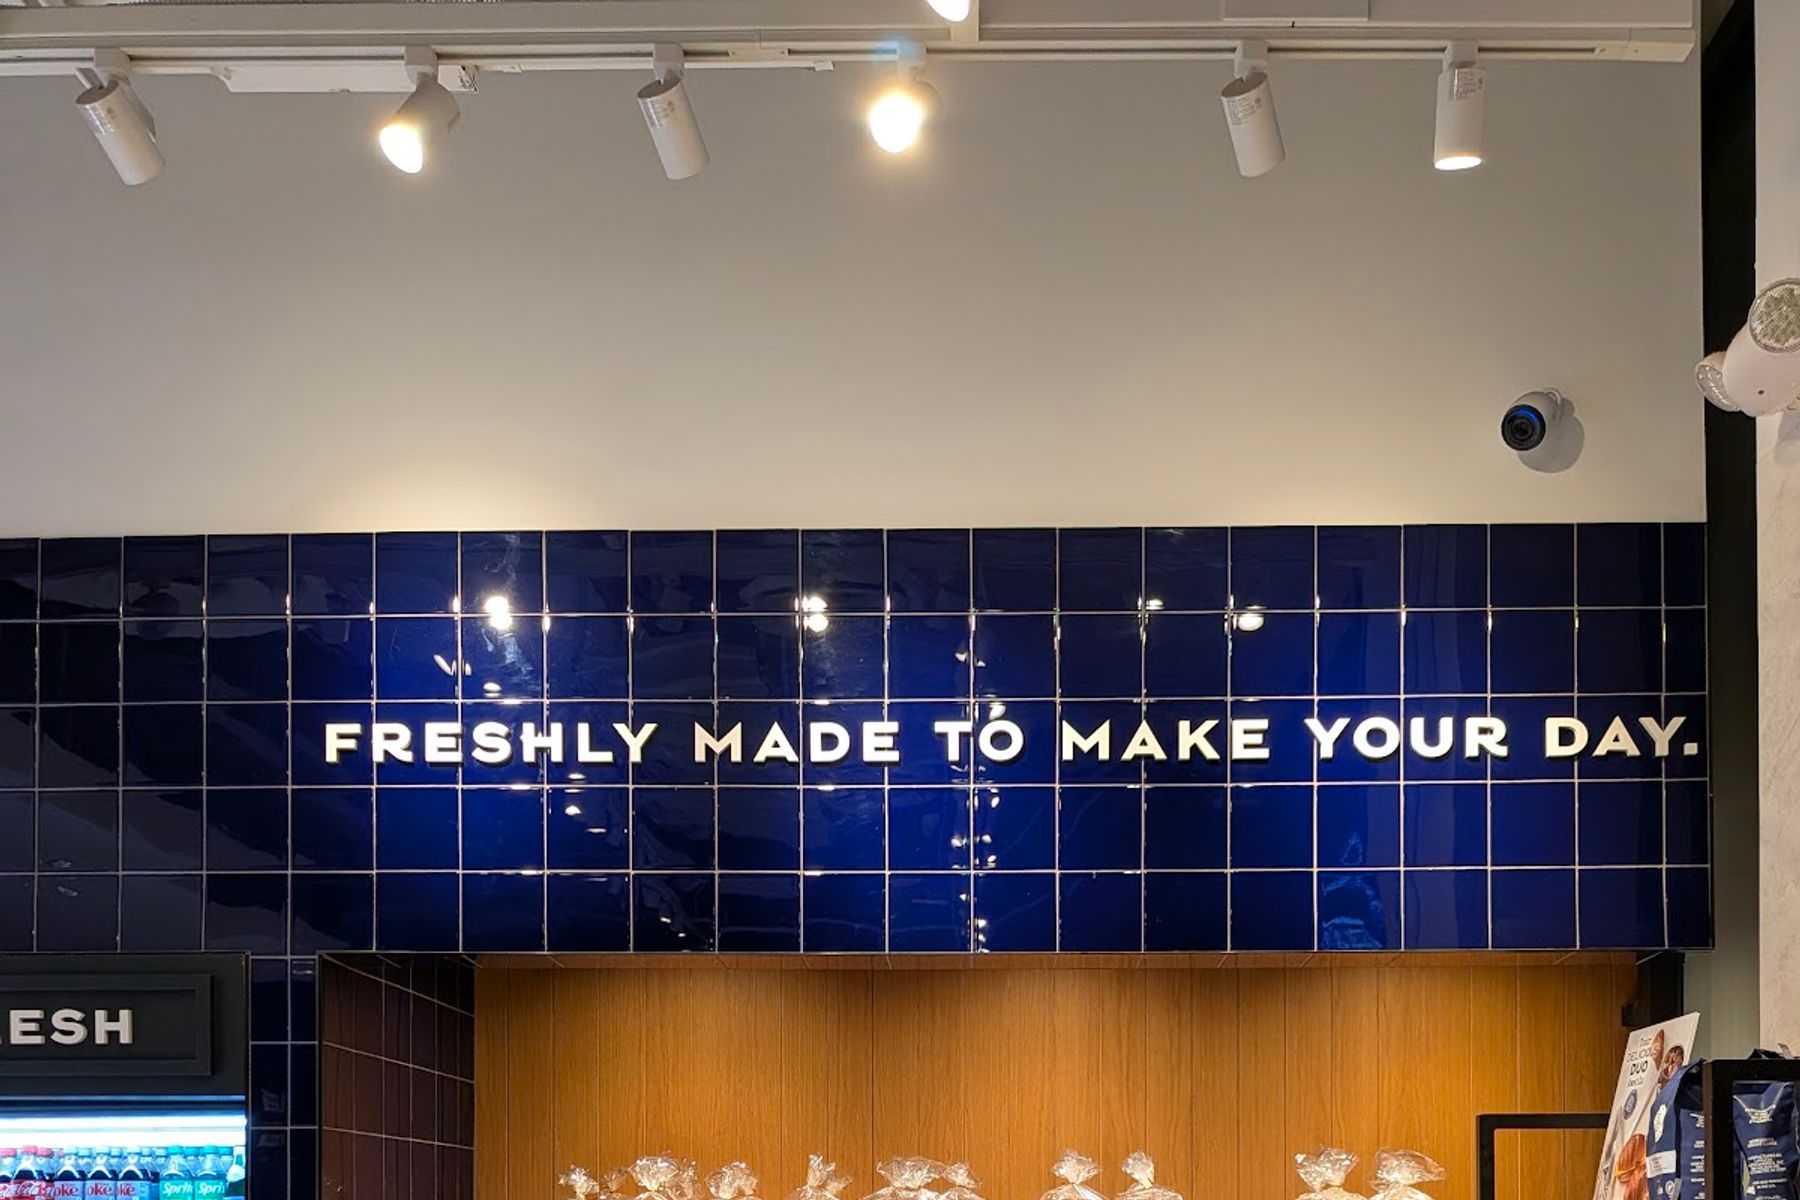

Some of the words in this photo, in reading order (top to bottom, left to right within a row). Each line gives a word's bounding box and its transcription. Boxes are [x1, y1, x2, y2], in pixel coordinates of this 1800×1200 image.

[325, 721, 658, 763] FRESHLY
[694, 720, 900, 762] MADE
[934, 719, 1024, 762] TO
[1062, 718, 1271, 761] MAKE
[1304, 716, 1508, 759] YOUR
[1545, 715, 1698, 758] DAY.
[0, 1008, 133, 1045] ESH
[87, 1183, 112, 1197] oke
